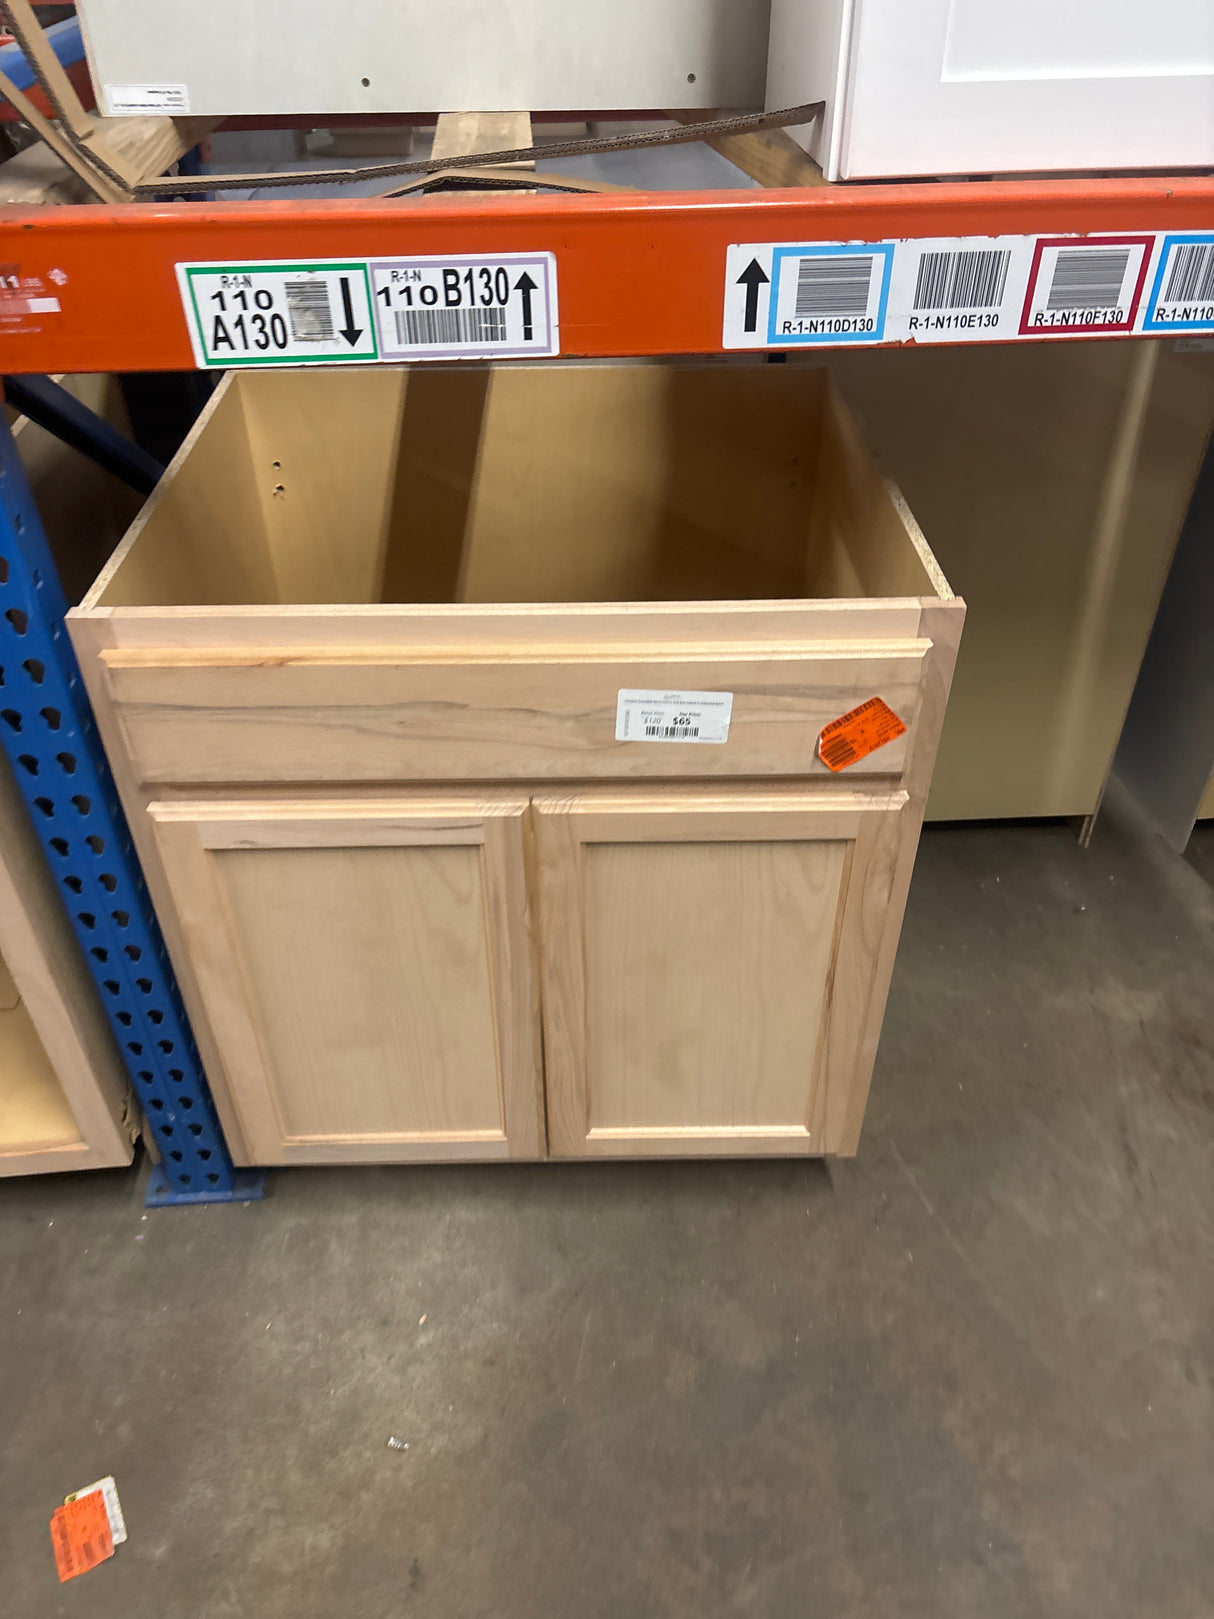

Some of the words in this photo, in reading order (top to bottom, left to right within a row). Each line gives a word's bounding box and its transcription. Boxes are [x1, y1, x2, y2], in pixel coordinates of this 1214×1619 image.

[220, 274, 253, 289] R-1-N
[391, 269, 422, 283] R-1-N
[377, 285, 439, 307] 110
[443, 267, 510, 307] B130
[211, 290, 273, 312] 110
[908, 313, 999, 330] R-1-N110E130
[1033, 309, 1123, 327] R-1-N110F130
[1155, 306, 1214, 321] R-1-N110
[211, 312, 288, 351] A130
[782, 317, 874, 334] R-1-N110D130
[673, 716, 691, 726] $65
